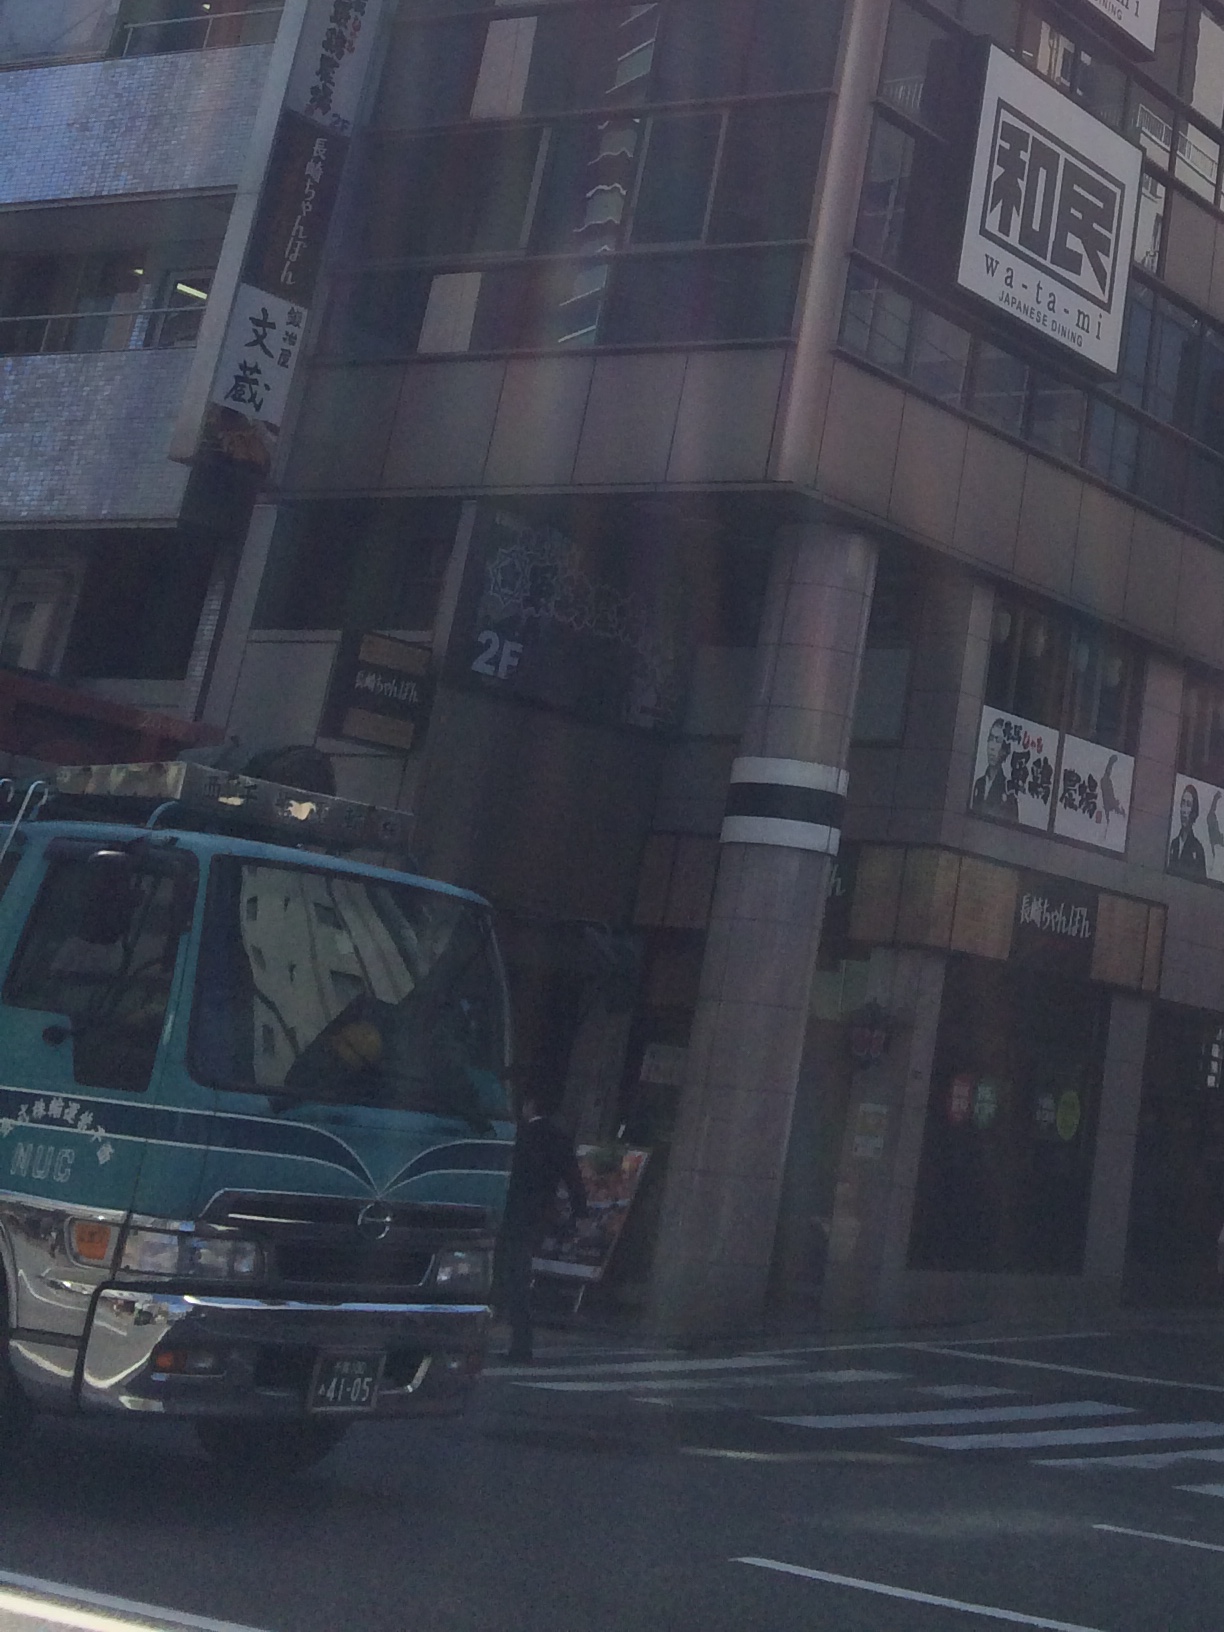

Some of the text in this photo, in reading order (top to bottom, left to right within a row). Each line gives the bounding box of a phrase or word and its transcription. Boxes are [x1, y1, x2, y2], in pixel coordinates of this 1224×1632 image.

[280, 136, 328, 287] 長崎ちゃんぽん
[990, 125, 1117, 298] 和民
[983, 252, 1103, 342] wa-ta-mi
[998, 290, 1084, 350] JAPANESE DINING
[225, 308, 273, 412] 文蔵
[472, 629, 524, 680] 2F
[1020, 894, 1092, 939] 長崎ちゃんぽん
[10, 1141, 76, 1183] NUC
[326, 1376, 373, 1402] 41-05
